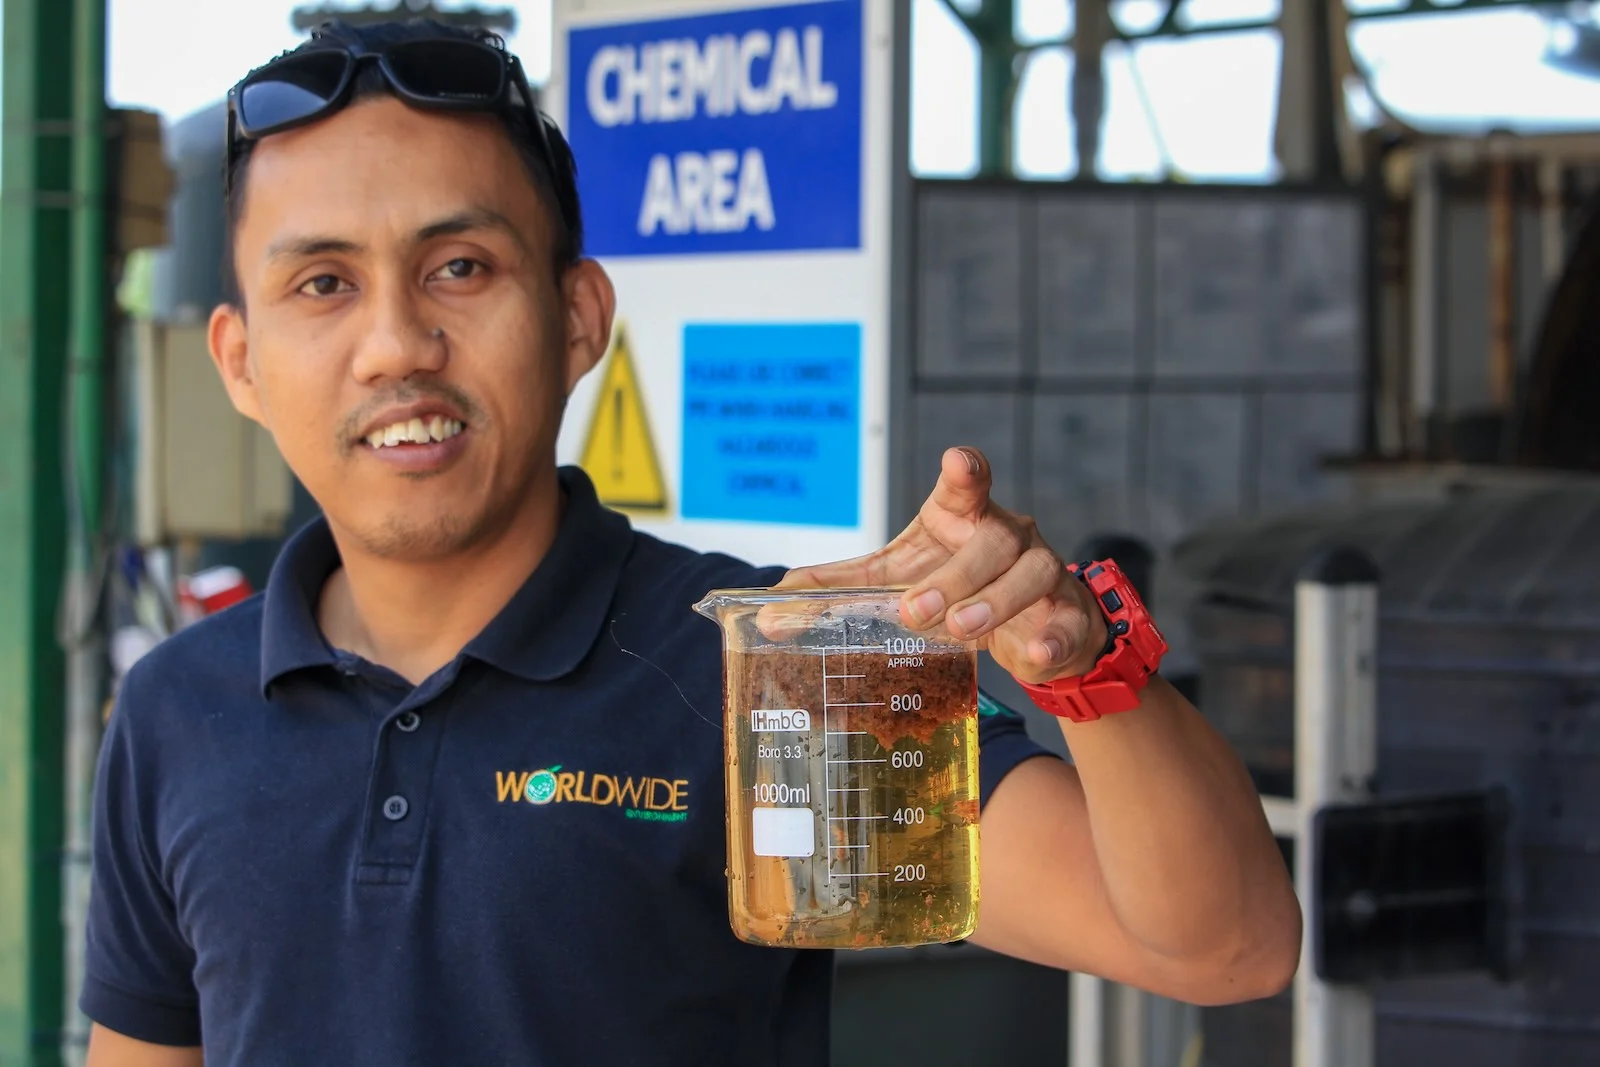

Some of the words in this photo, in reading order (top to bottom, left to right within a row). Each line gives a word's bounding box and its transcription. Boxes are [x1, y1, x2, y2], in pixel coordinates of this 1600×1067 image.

[586, 25, 838, 128] CHEMICAL
[637, 147, 776, 237] AREA
[885, 637, 926, 655] 1000
[887, 656, 925, 669] APPROX
[890, 693, 923, 712] 800
[758, 744, 781, 758] Boro
[784, 745, 802, 759] 3.3
[891, 750, 924, 769] 600
[495, 767, 689, 811] WORLDWIDE
[753, 783, 811, 803] 1000ml
[892, 807, 925, 825] 400
[894, 863, 927, 882] 200
